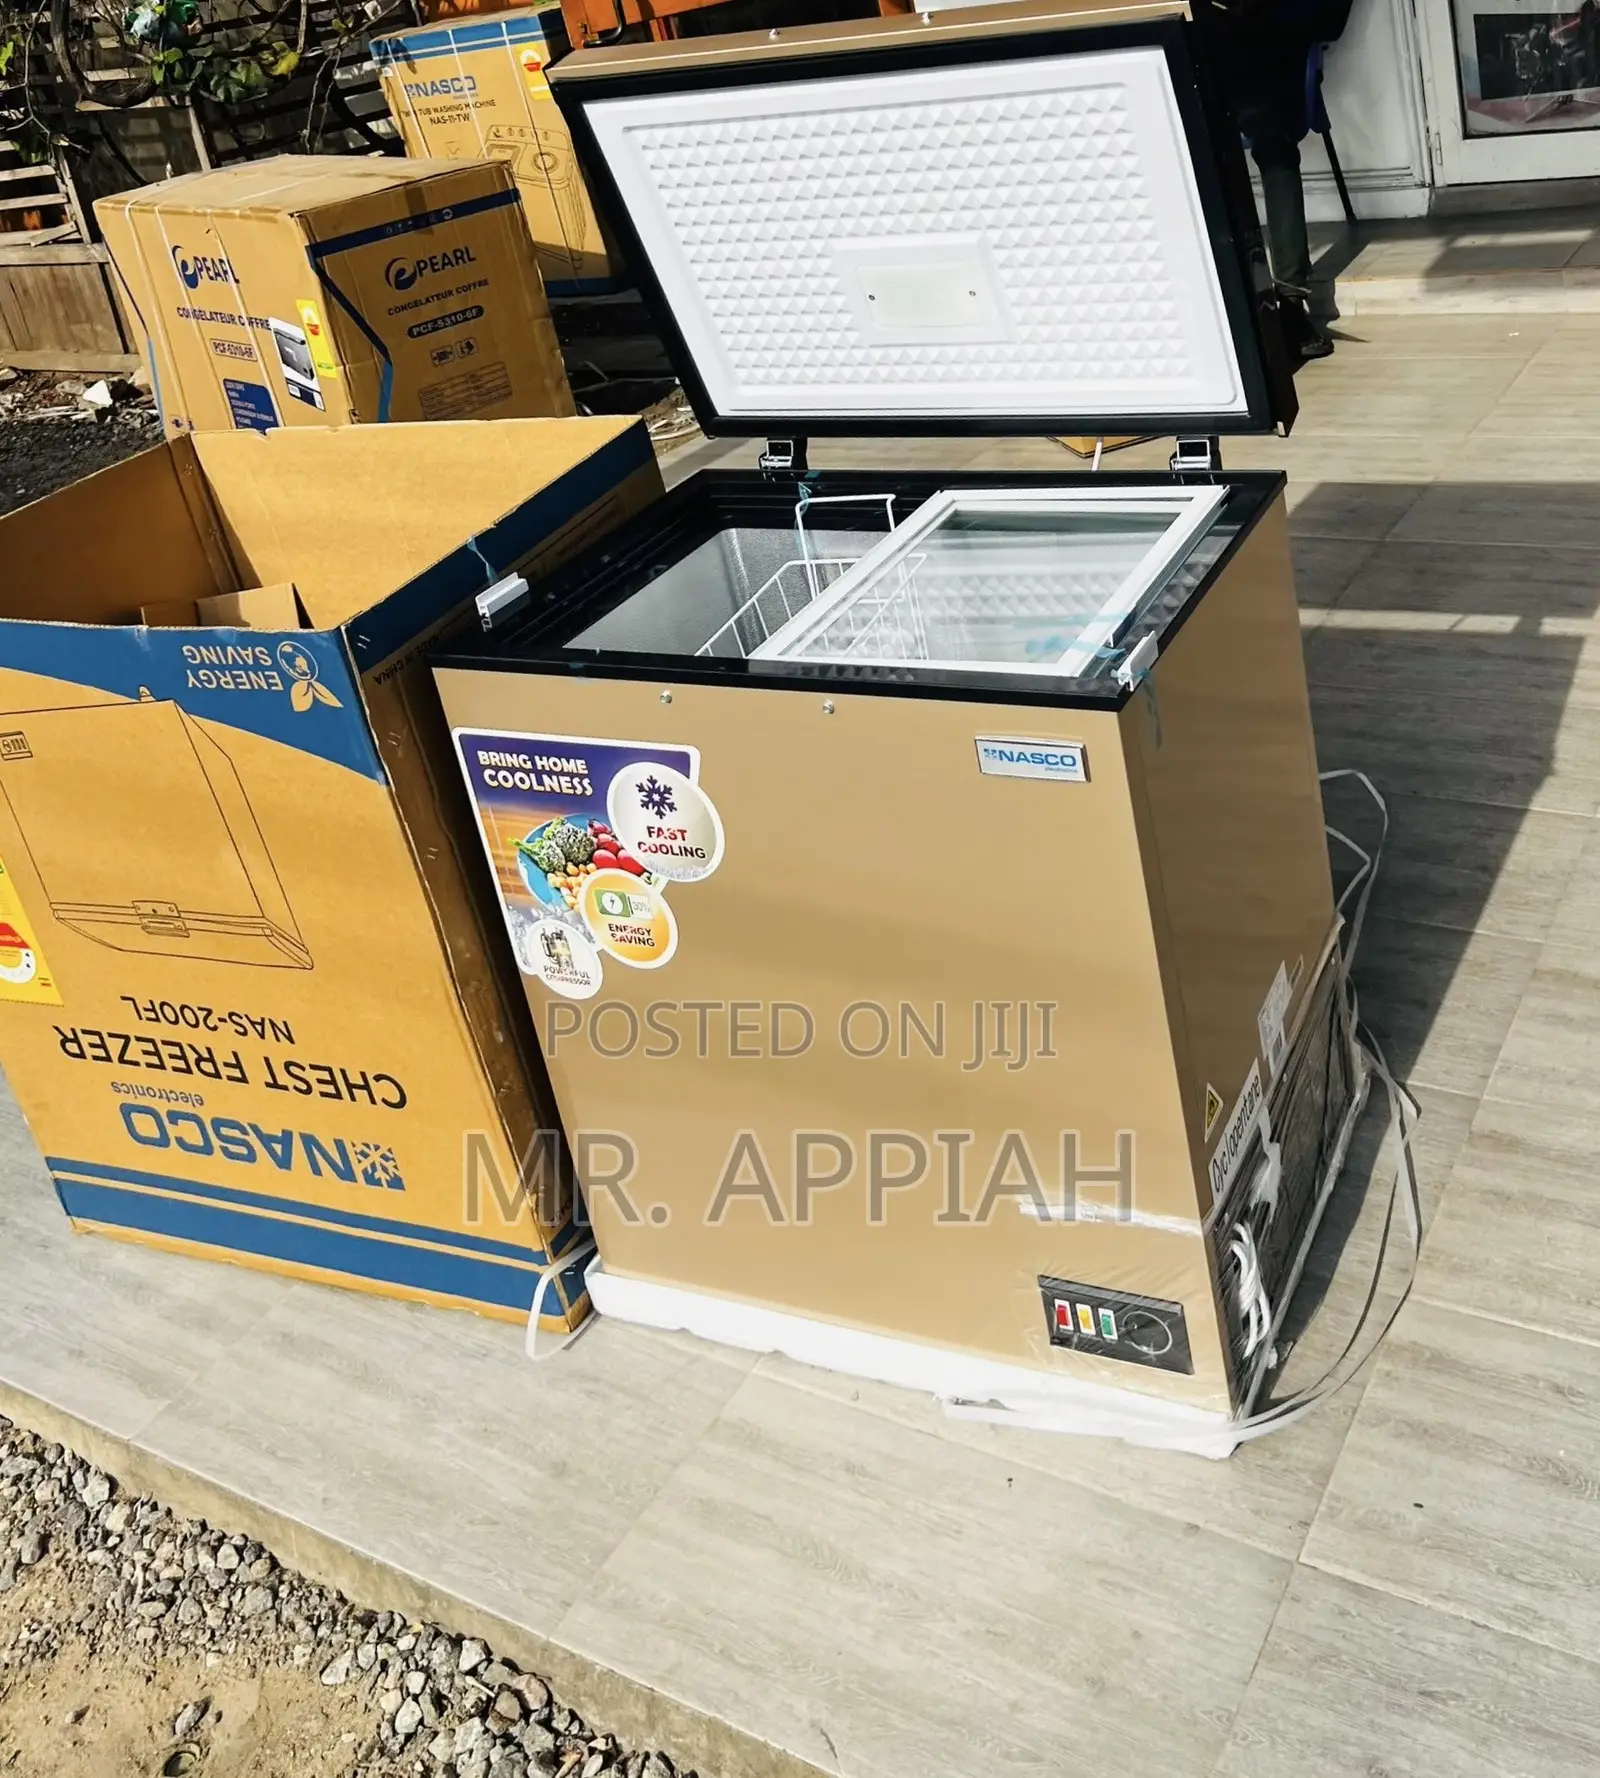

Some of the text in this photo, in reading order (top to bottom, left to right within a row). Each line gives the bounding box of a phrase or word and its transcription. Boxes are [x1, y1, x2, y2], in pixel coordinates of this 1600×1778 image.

[414, 76, 477, 97] NASCO
[418, 107, 432, 116] TUB
[432, 104, 463, 114] WASHING
[416, 246, 477, 279] PEARL
[388, 278, 490, 316] CONGELATEUR COFFRE
[237, 314, 272, 331] CFFRE
[182, 644, 273, 667] SAVING
[187, 668, 284, 692] ENERGY
[476, 750, 589, 775] BRING HOME
[998, 750, 1077, 767] NASCO
[483, 768, 594, 797] COOLNESS
[646, 825, 688, 842] FAST
[637, 841, 706, 860] COOLING
[608, 923, 652, 937] ENERGY
[611, 933, 656, 947] SAVING
[120, 995, 296, 1045] NAS-200FL
[51, 1025, 408, 1110] CHEST FREEZER
[112, 1080, 205, 1107] electronics
[118, 1101, 358, 1184] NASCO
